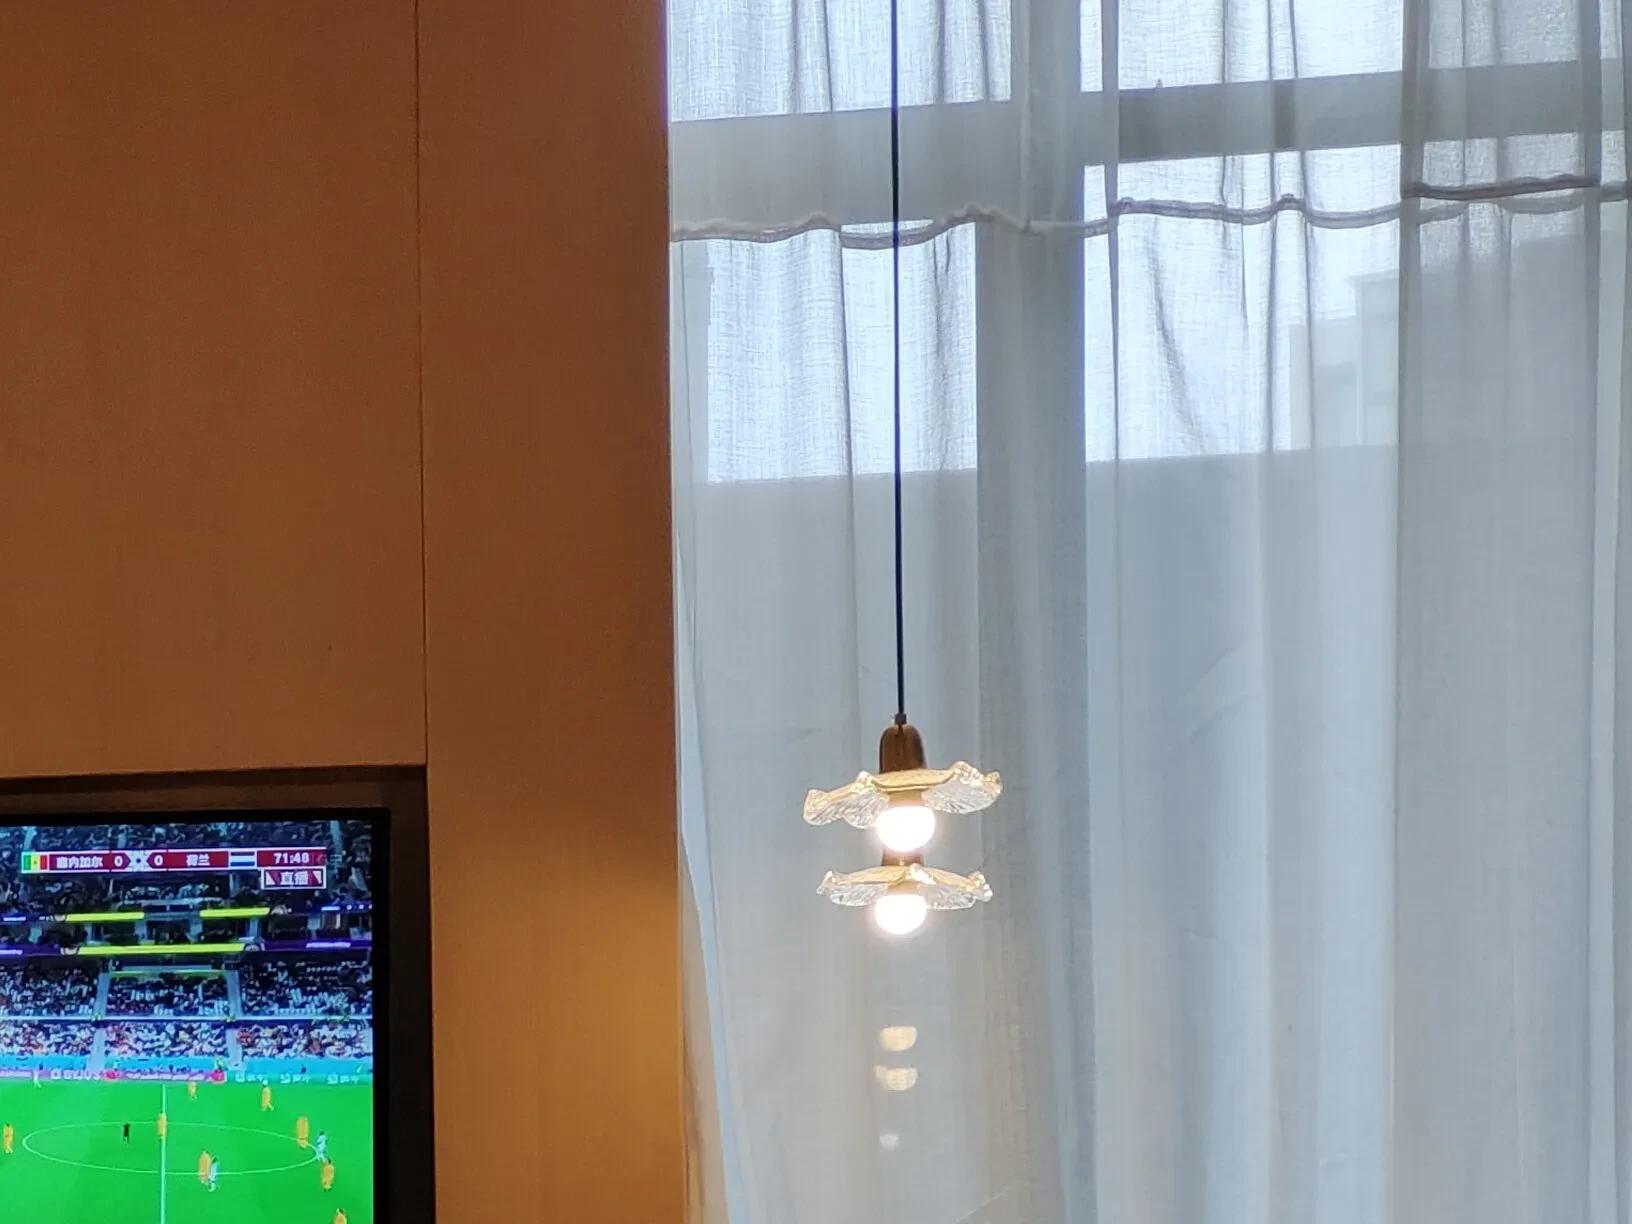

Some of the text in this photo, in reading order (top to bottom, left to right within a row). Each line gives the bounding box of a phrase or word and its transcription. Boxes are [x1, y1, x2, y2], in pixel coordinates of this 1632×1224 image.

[114, 855, 123, 867] 0
[154, 854, 163, 865] 0
[280, 870, 308, 885] 直播
